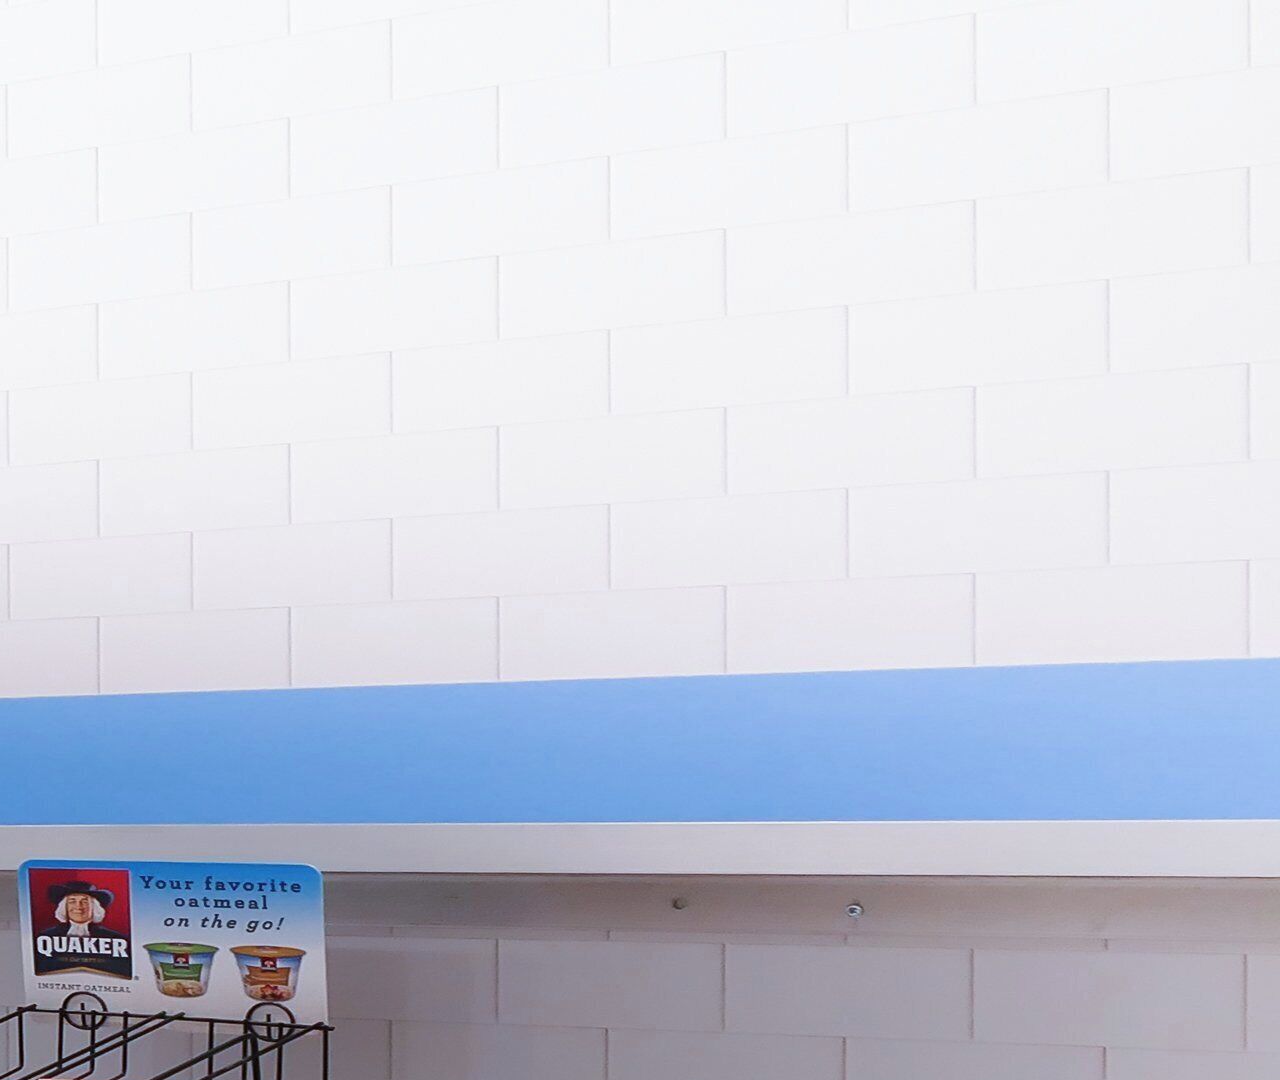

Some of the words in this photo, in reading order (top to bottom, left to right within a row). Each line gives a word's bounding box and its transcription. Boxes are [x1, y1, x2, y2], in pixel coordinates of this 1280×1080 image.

[139, 875, 194, 890] Your
[204, 876, 302, 893] favorite
[174, 895, 268, 910] oatmeal
[164, 917, 190, 928] on
[201, 914, 237, 929] the
[246, 917, 285, 933] go!
[37, 935, 129, 958] QUAKER
[37, 983, 81, 991] INSTANT
[83, 985, 132, 993] OATMEAL
